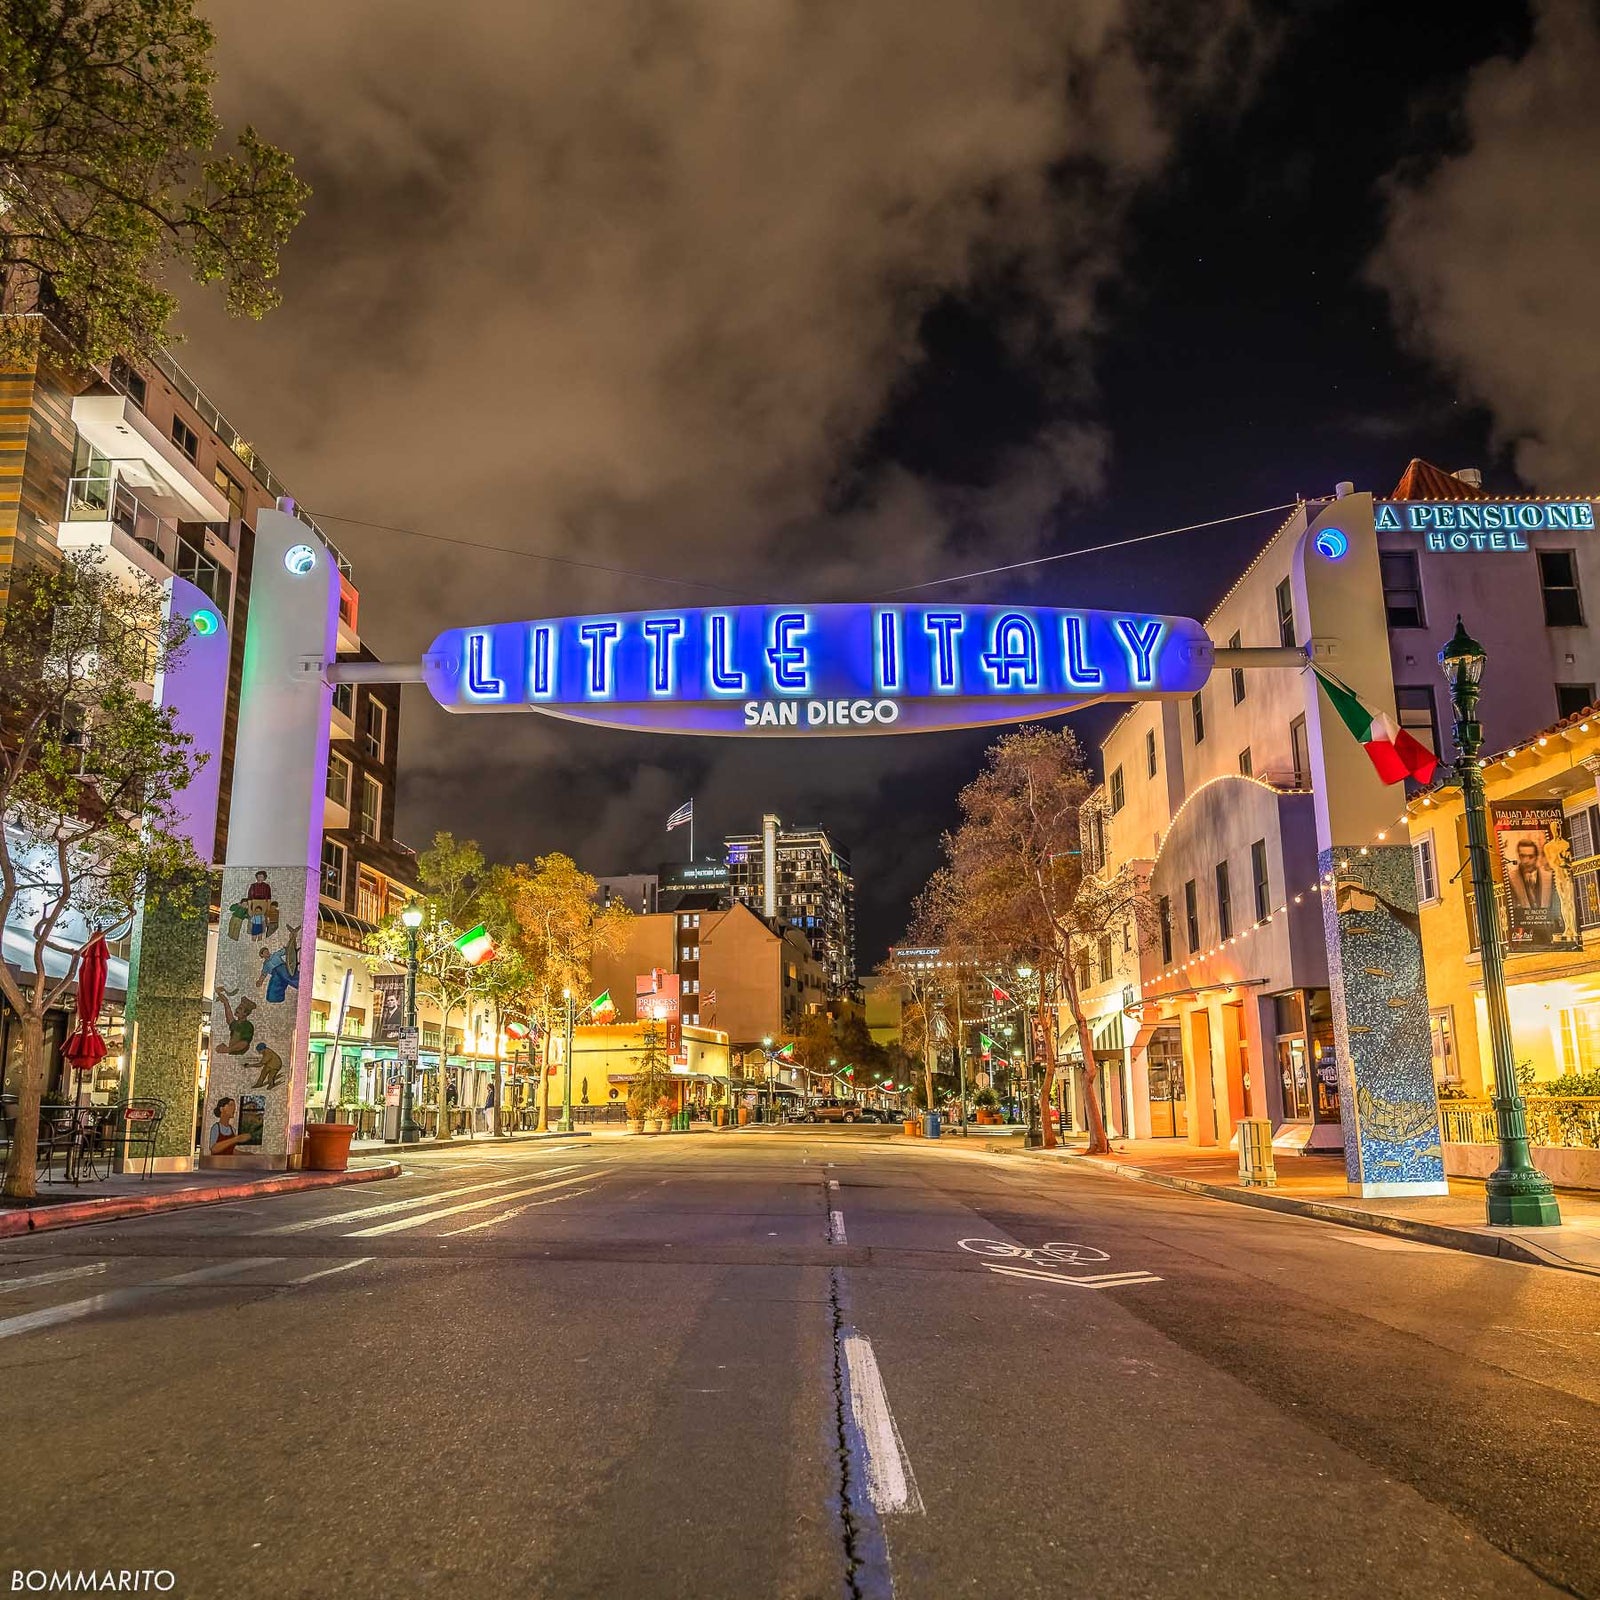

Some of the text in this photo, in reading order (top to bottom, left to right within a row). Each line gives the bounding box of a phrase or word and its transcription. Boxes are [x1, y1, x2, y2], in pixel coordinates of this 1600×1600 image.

[1410, 503, 1593, 530] PENSIONE
[1428, 531, 1527, 549] HOTEL
[467, 611, 1164, 695] LITTLE ITALY
[744, 701, 899, 725] SAN DIEGO
[1496, 809, 1562, 819] ITALIAN AMERICAN
[669, 1025, 677, 1049] PUB
